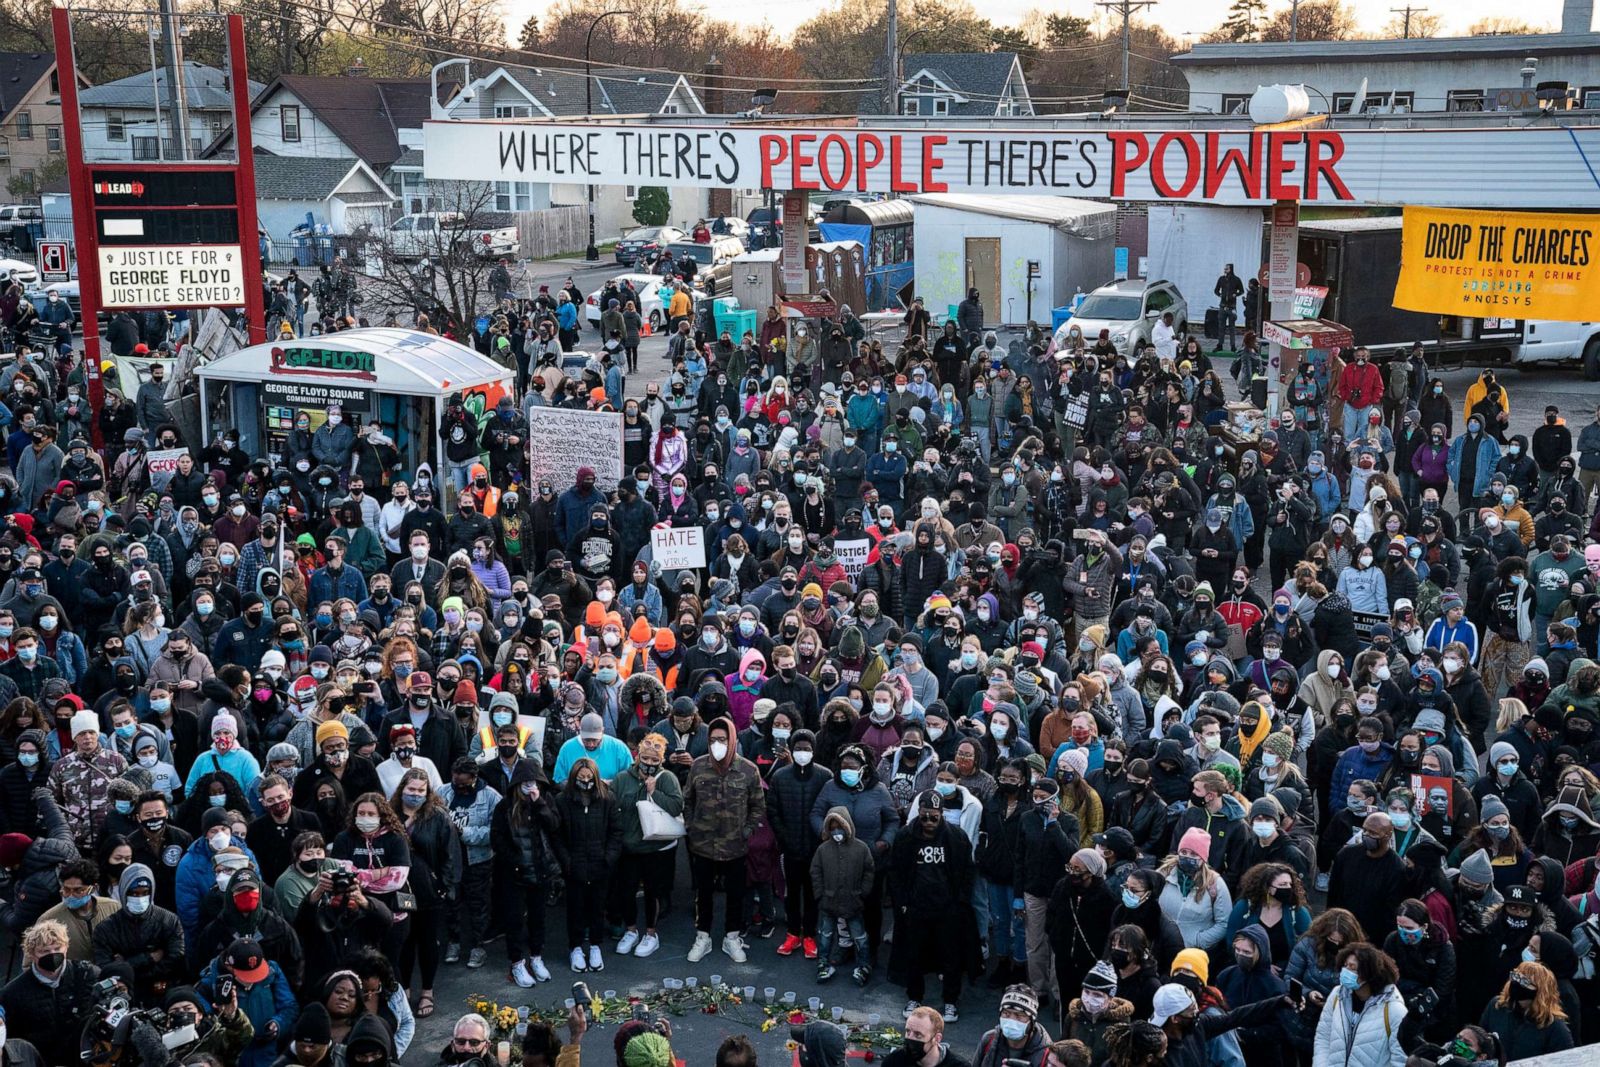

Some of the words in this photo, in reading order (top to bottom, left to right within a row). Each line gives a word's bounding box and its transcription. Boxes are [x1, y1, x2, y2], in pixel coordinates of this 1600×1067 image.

[500, 130, 601, 175] WHERE
[616, 130, 740, 184] THERE'S
[759, 133, 948, 193] PEOPLE
[958, 139, 1098, 188] THERE'S
[1107, 131, 1355, 200] POWER
[1425, 223, 1472, 260] DROP
[1478, 225, 1506, 262] THE
[1512, 228, 1592, 266] CHARGES
[121, 251, 183, 265] JUSTICE
[192, 250, 217, 265] FOR
[110, 270, 168, 285] GEORGE
[181, 270, 230, 284] FLOYD
[1300, 272, 1305, 280] 1
[1426, 265, 1473, 276] PROTEST
[1482, 268, 1493, 277] IS
[1499, 268, 1519, 278] NOT
[1529, 270, 1534, 279] A
[1545, 271, 1582, 280] CRIME
[111, 288, 170, 303] JUSTICE
[1295, 296, 1313, 307] LIVES
[265, 383, 299, 395] GEORGE
[300, 386, 327, 397] FLOYD
[329, 389, 364, 400] SQUARE
[286, 395, 326, 405] COMMUNITY
[1064, 410, 1085, 424] FLOYD
[1067, 403, 1088, 416] GEORGE
[657, 530, 697, 547] HATE
[582, 541, 613, 556] PENGUINS
[664, 557, 689, 567] VIRUS
[1412, 776, 1421, 787] DO
